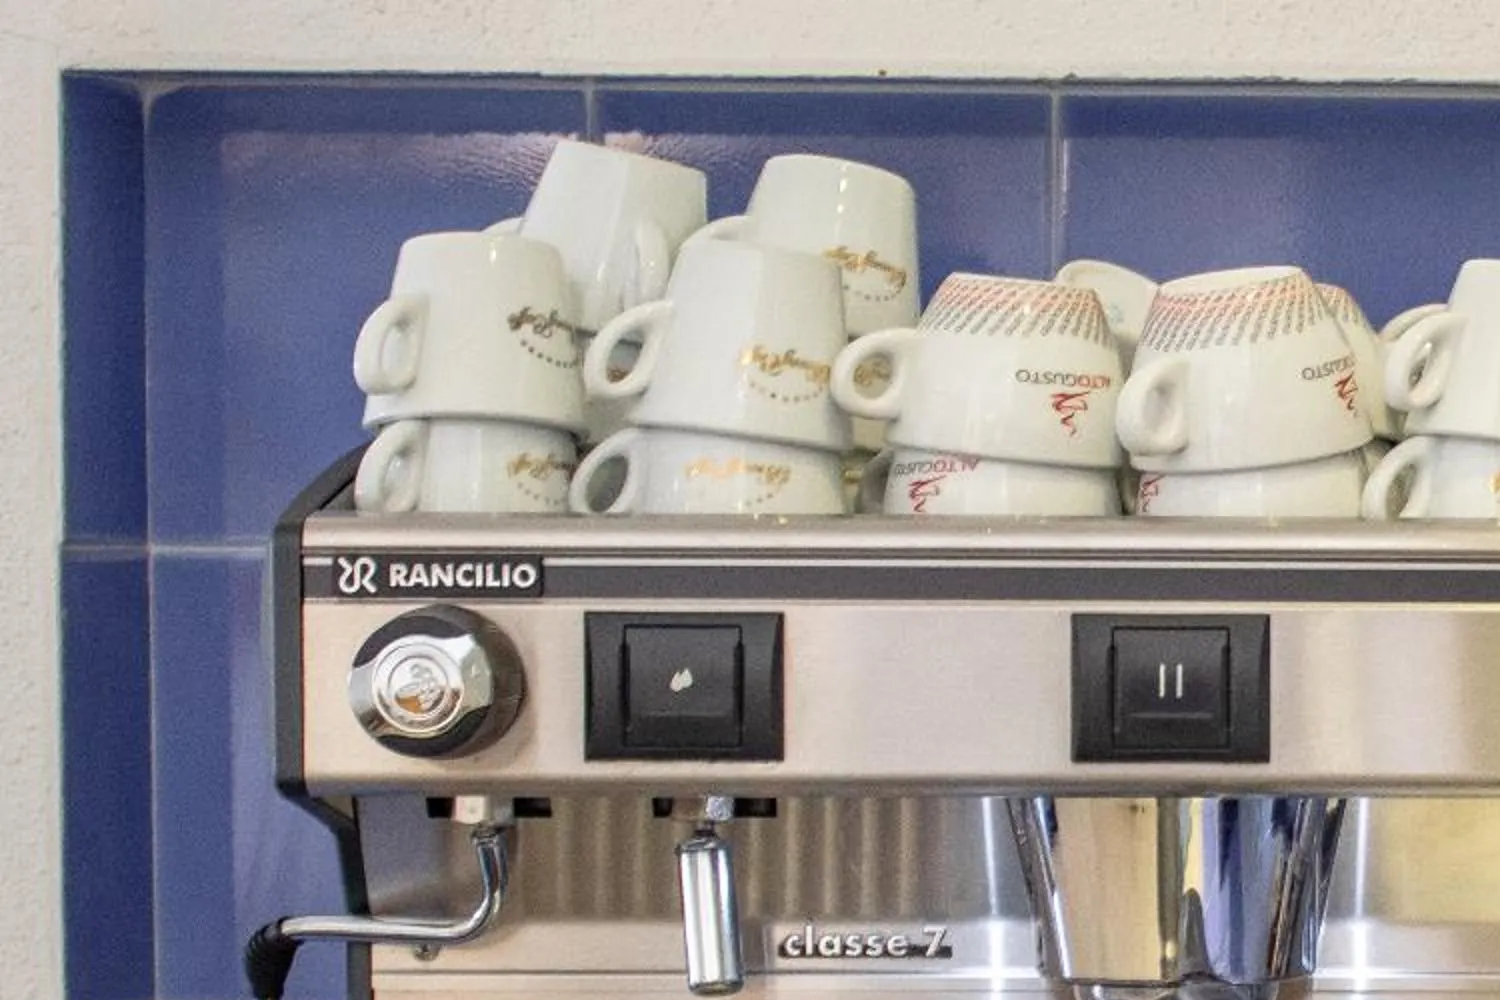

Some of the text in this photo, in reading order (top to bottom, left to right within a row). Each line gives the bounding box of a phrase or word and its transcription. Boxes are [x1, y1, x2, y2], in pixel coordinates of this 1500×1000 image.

[389, 562, 537, 588] RANCILIO
[784, 925, 948, 957] classe 7
